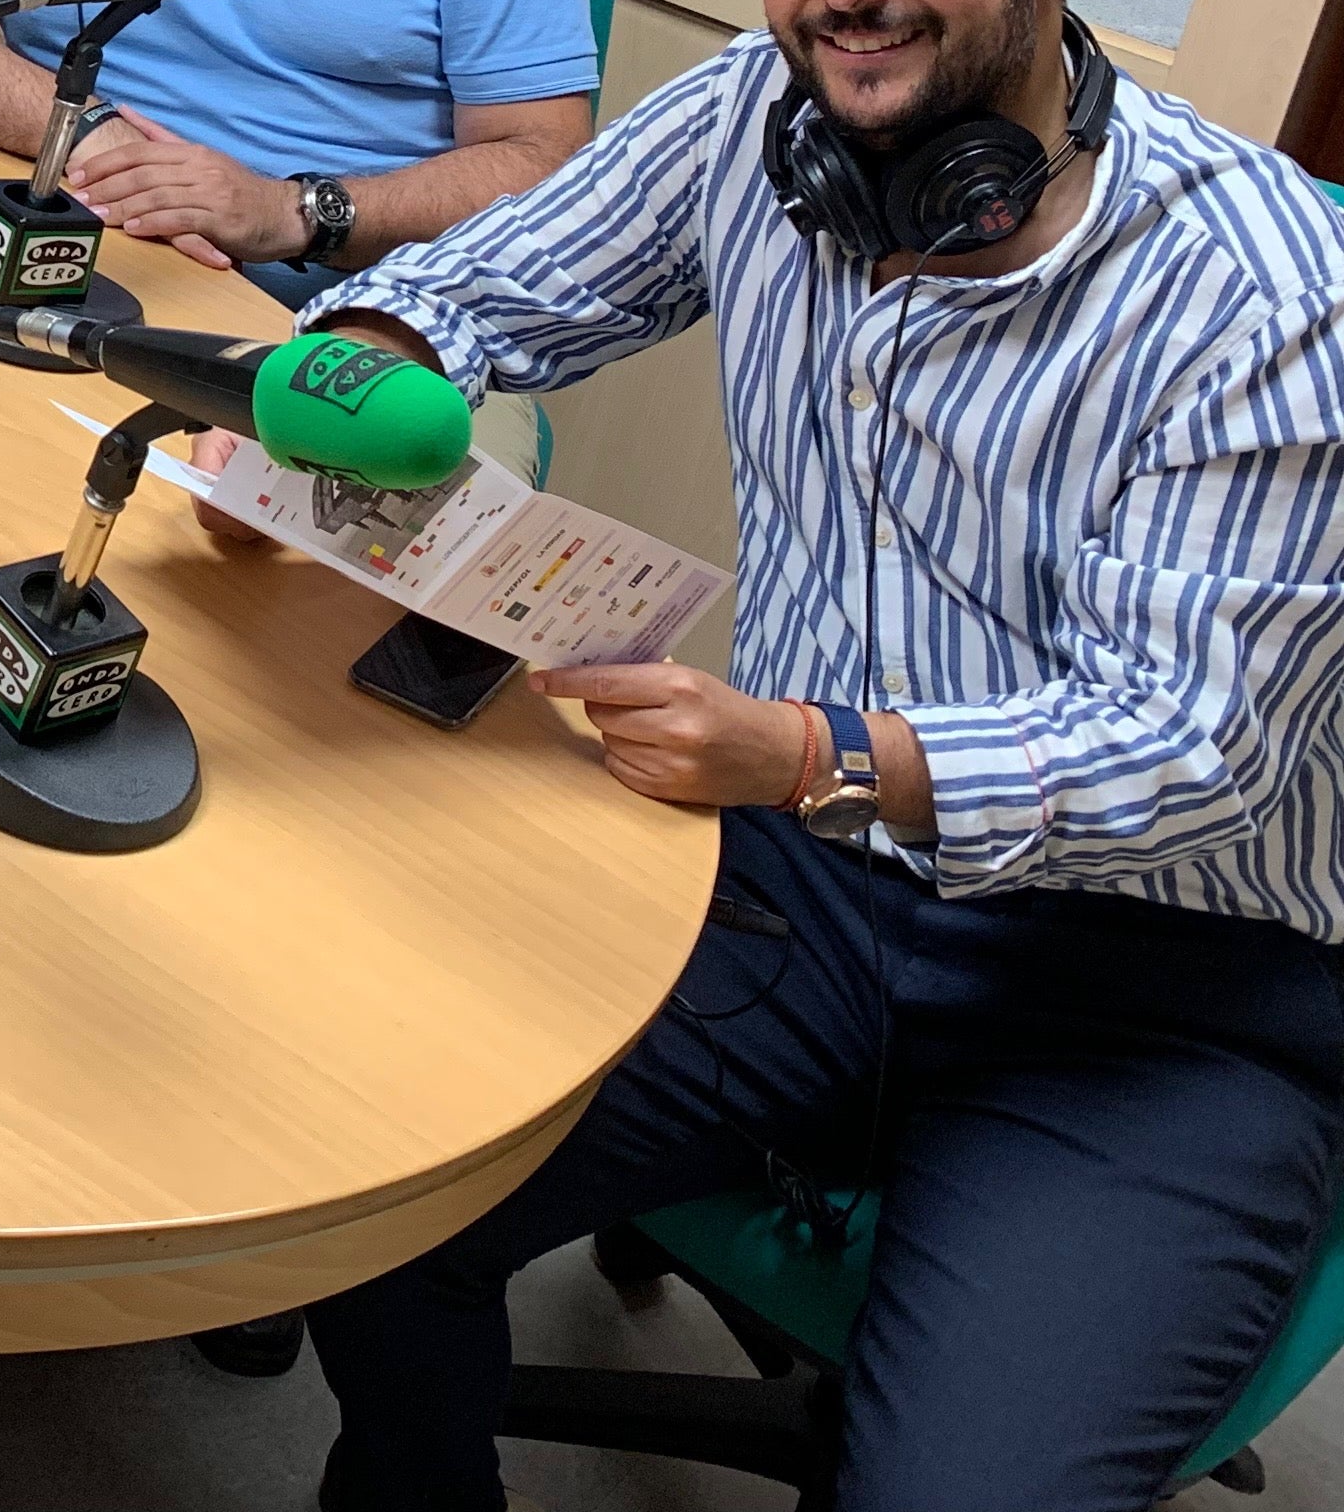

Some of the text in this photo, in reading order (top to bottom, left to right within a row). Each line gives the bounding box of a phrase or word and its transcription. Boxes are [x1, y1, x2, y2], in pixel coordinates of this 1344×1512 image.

[32, 247, 82, 259] ONDA
[30, 268, 76, 281] CERO
[63, 665, 120, 691] ONDA
[58, 687, 112, 712] CERO
